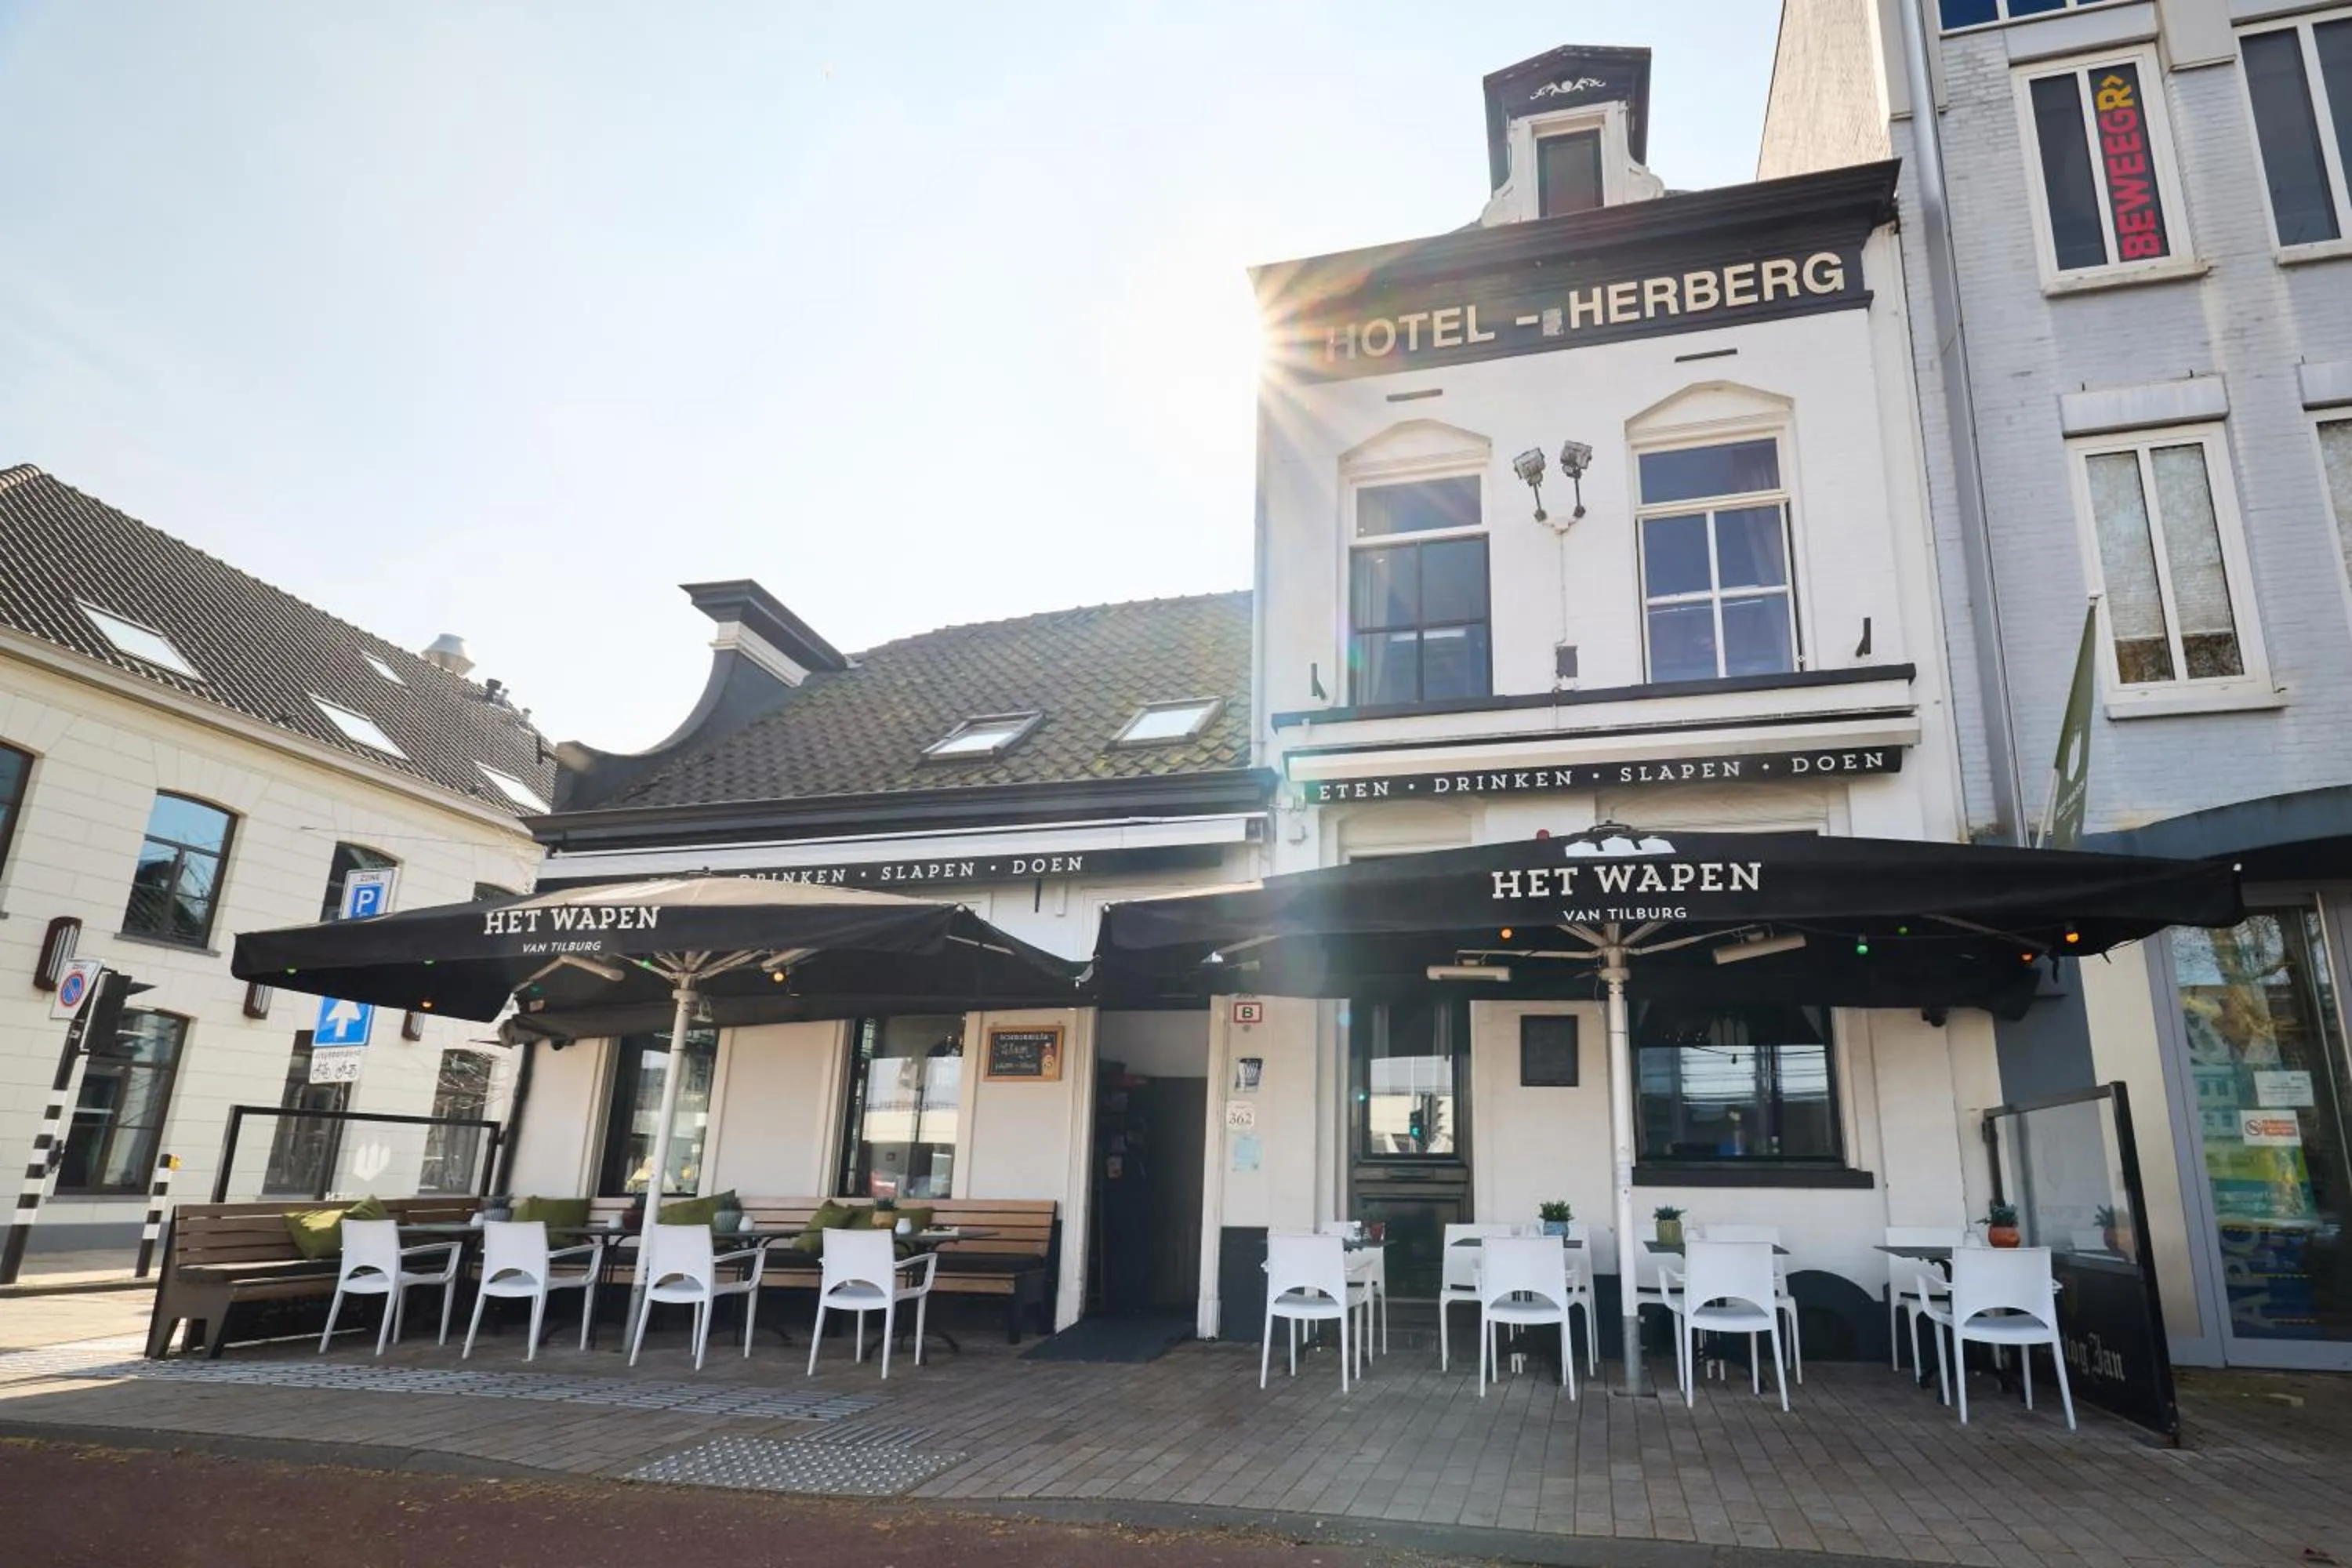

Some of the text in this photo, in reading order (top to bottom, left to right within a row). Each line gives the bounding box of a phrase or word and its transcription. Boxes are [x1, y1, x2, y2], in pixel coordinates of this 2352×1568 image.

[1324, 304, 1496, 363] HOTEL
[1570, 252, 1846, 330] HERBERG
[1319, 751, 1884, 801] ETEN DRINKEN SLAPEN DOEN
[880, 862, 975, 880] SLAPEN
[1011, 856, 1083, 874] DOEN
[1491, 861, 1763, 900] HET WAPEN
[356, 890, 375, 913] P
[483, 906, 662, 935] HET WAPEN
[1563, 906, 1688, 922] VAN TILBURG
[522, 940, 602, 954] VAN TILBURG
[1241, 1006, 1254, 1018] B
[1229, 1112, 1253, 1125] 362
